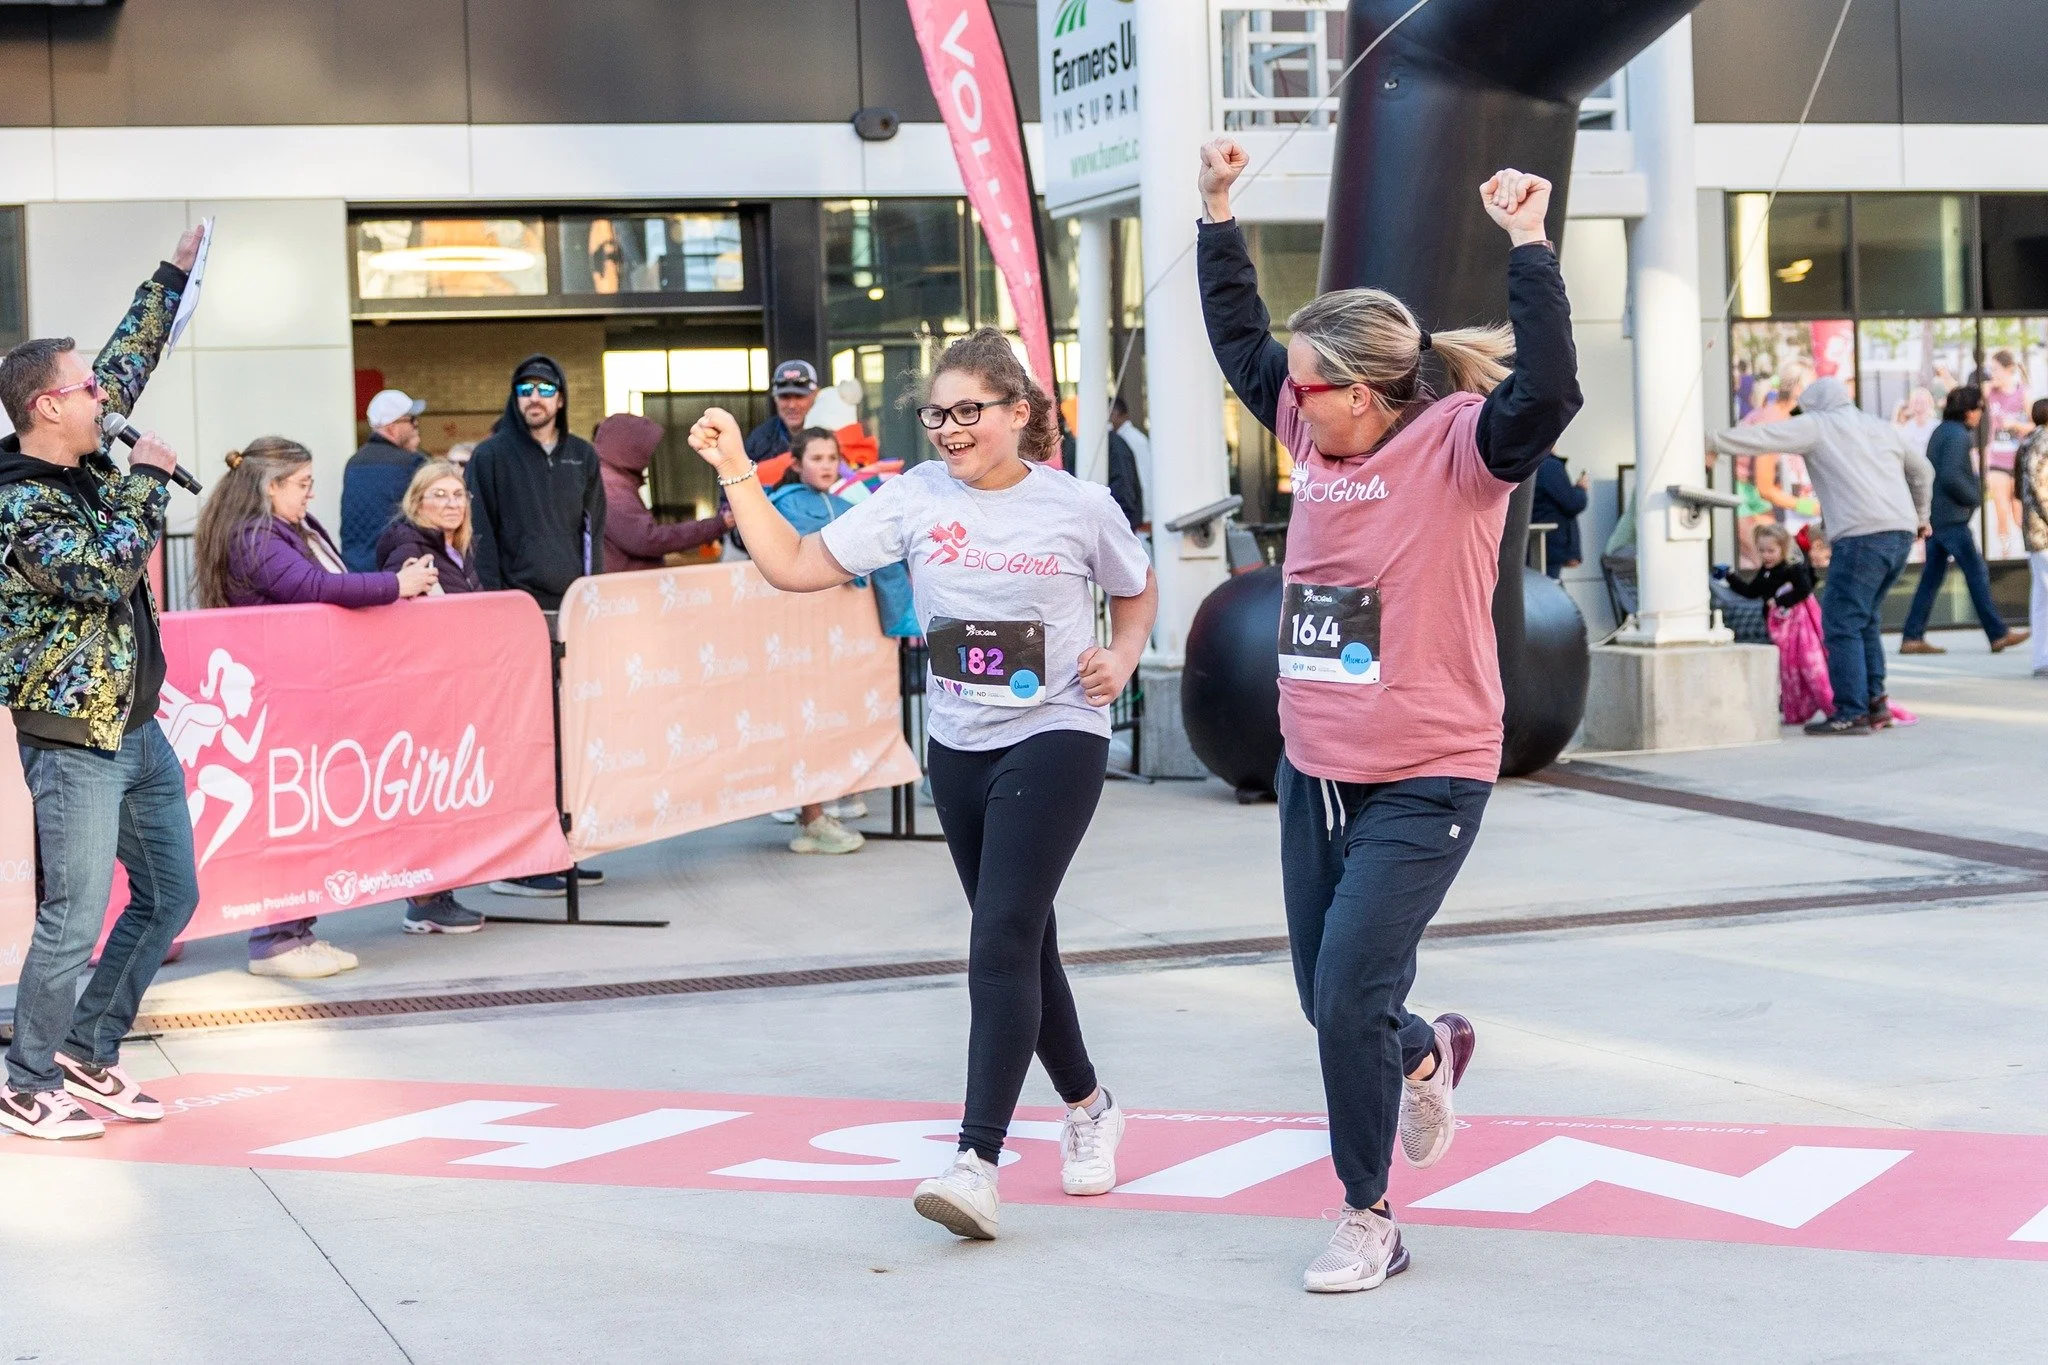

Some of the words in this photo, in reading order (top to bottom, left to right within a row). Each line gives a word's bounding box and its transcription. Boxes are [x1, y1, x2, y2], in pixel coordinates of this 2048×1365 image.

[1052, 41, 1118, 96] Farmers
[964, 548, 1062, 576] BIOGirls
[1292, 613, 1341, 648] 164
[957, 646, 1004, 676] 182
[268, 723, 495, 838] BIOGirls
[358, 867, 434, 895] signbadgers
[221, 902, 262, 919] Signage
[263, 892, 306, 912] Provided
